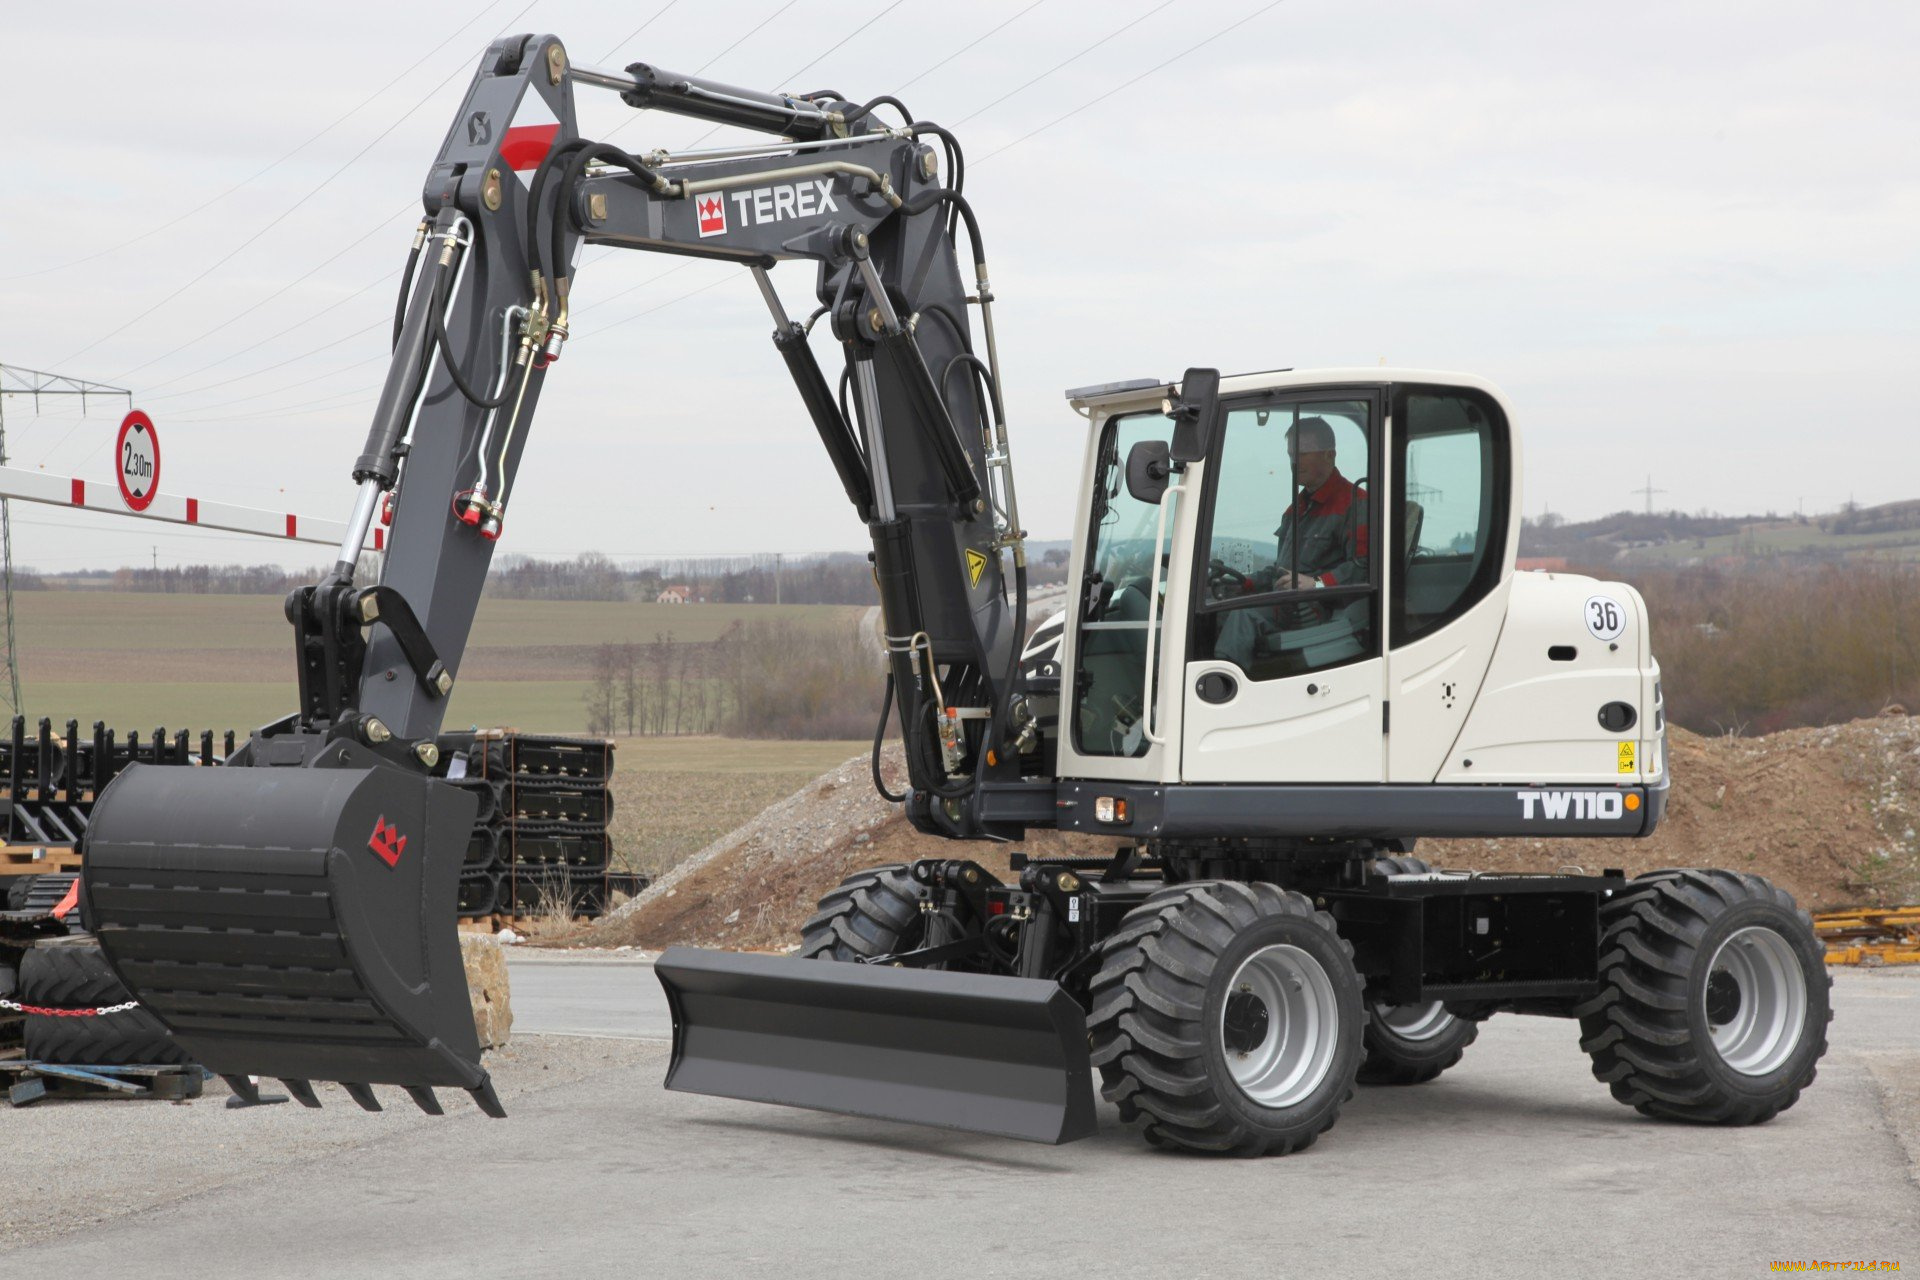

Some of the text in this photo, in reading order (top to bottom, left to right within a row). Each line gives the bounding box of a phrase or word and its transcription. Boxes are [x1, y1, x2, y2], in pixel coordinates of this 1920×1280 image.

[731, 178, 839, 227] TEREX
[1591, 601, 1618, 631] 36
[1517, 792, 1623, 819] TW110
